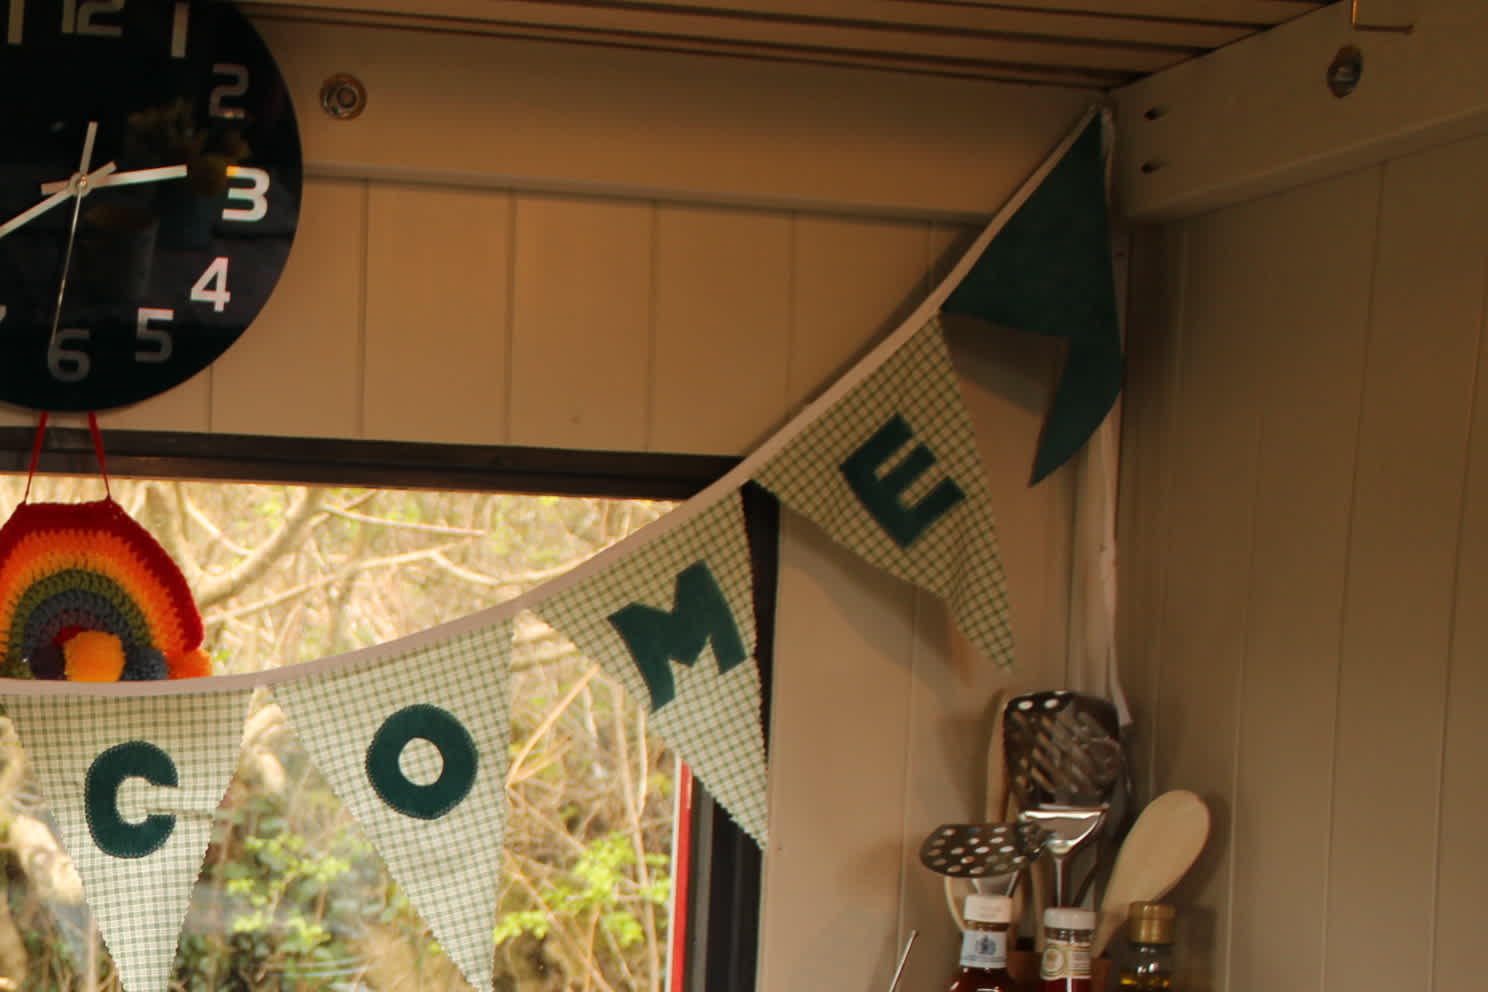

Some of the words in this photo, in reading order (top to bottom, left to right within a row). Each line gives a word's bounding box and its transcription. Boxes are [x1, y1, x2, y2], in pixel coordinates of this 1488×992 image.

[61, 0, 124, 38] 12
[170, 2, 190, 59] 1
[208, 63, 250, 119] 2
[221, 165, 271, 222] 3
[190, 256, 231, 313] 4
[47, 327, 91, 382] 6
[135, 307, 174, 362] 5
